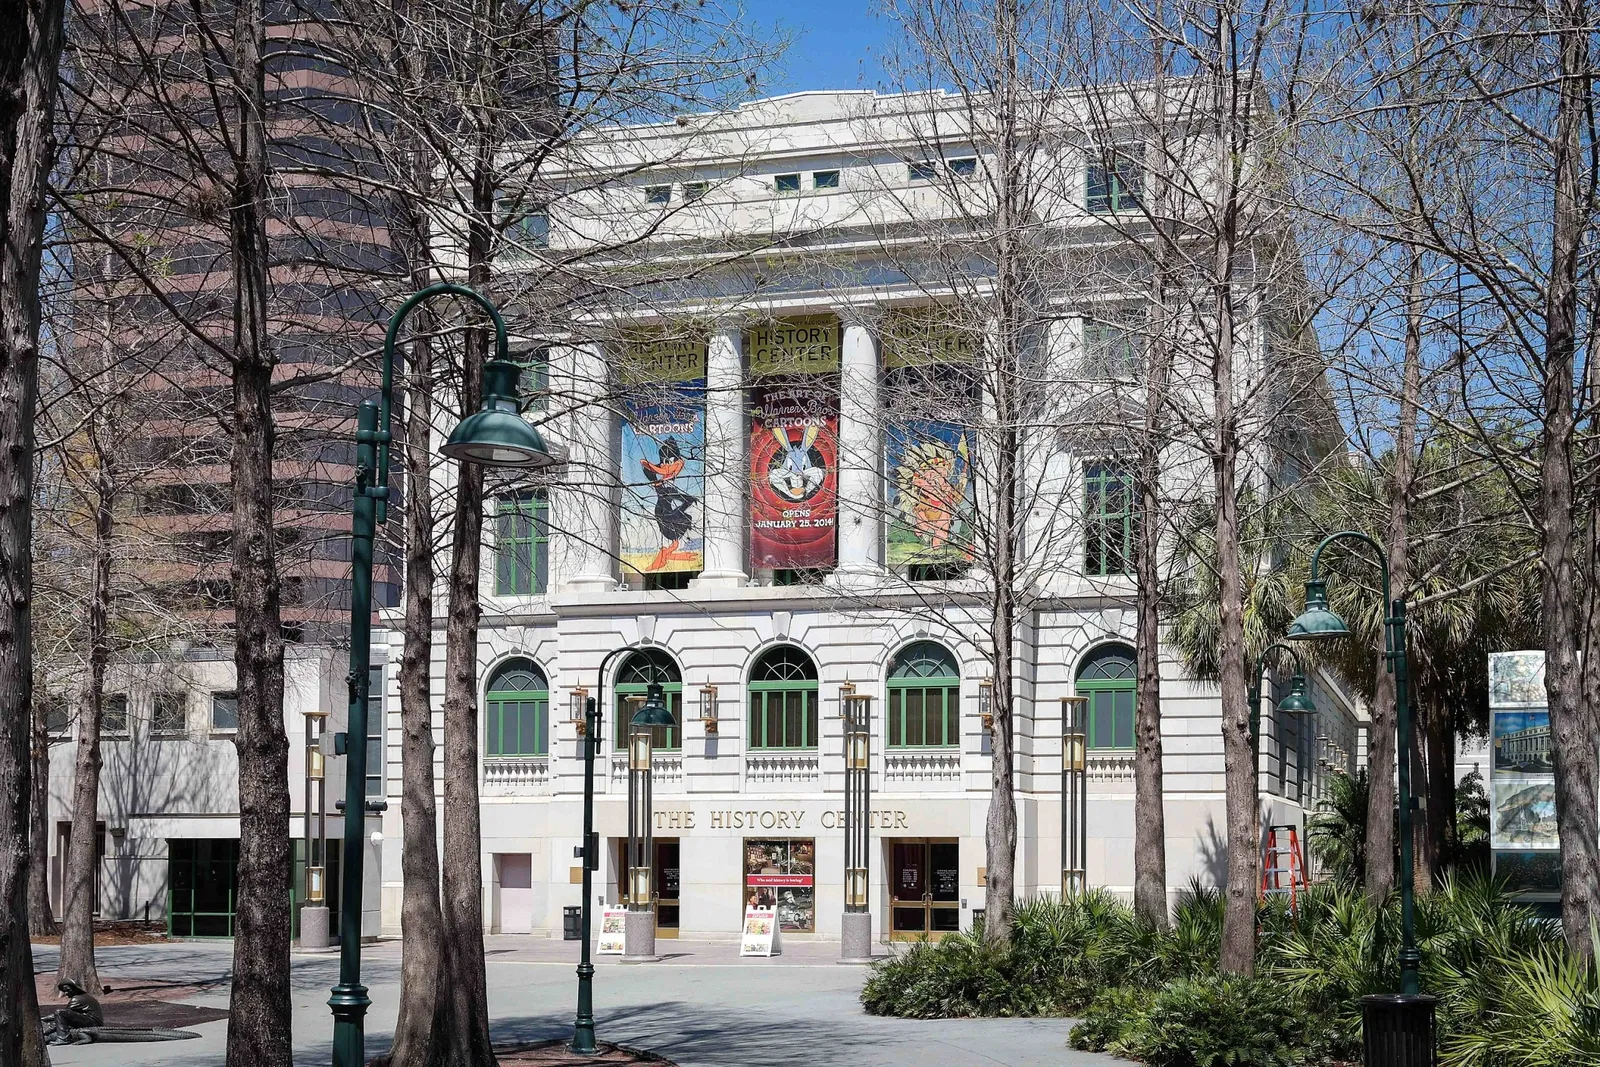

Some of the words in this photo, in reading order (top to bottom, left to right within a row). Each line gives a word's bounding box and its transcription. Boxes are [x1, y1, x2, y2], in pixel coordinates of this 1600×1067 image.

[757, 327, 832, 346] HISTORY
[757, 346, 832, 363] CENTER
[763, 391, 786, 402] THE
[755, 402, 800, 420] Warner
[764, 415, 827, 428] CARTOONS
[782, 509, 810, 518] OPENS
[755, 519, 797, 529] JANUARY
[653, 811, 696, 829] THE
[710, 811, 805, 829] HISTORY
